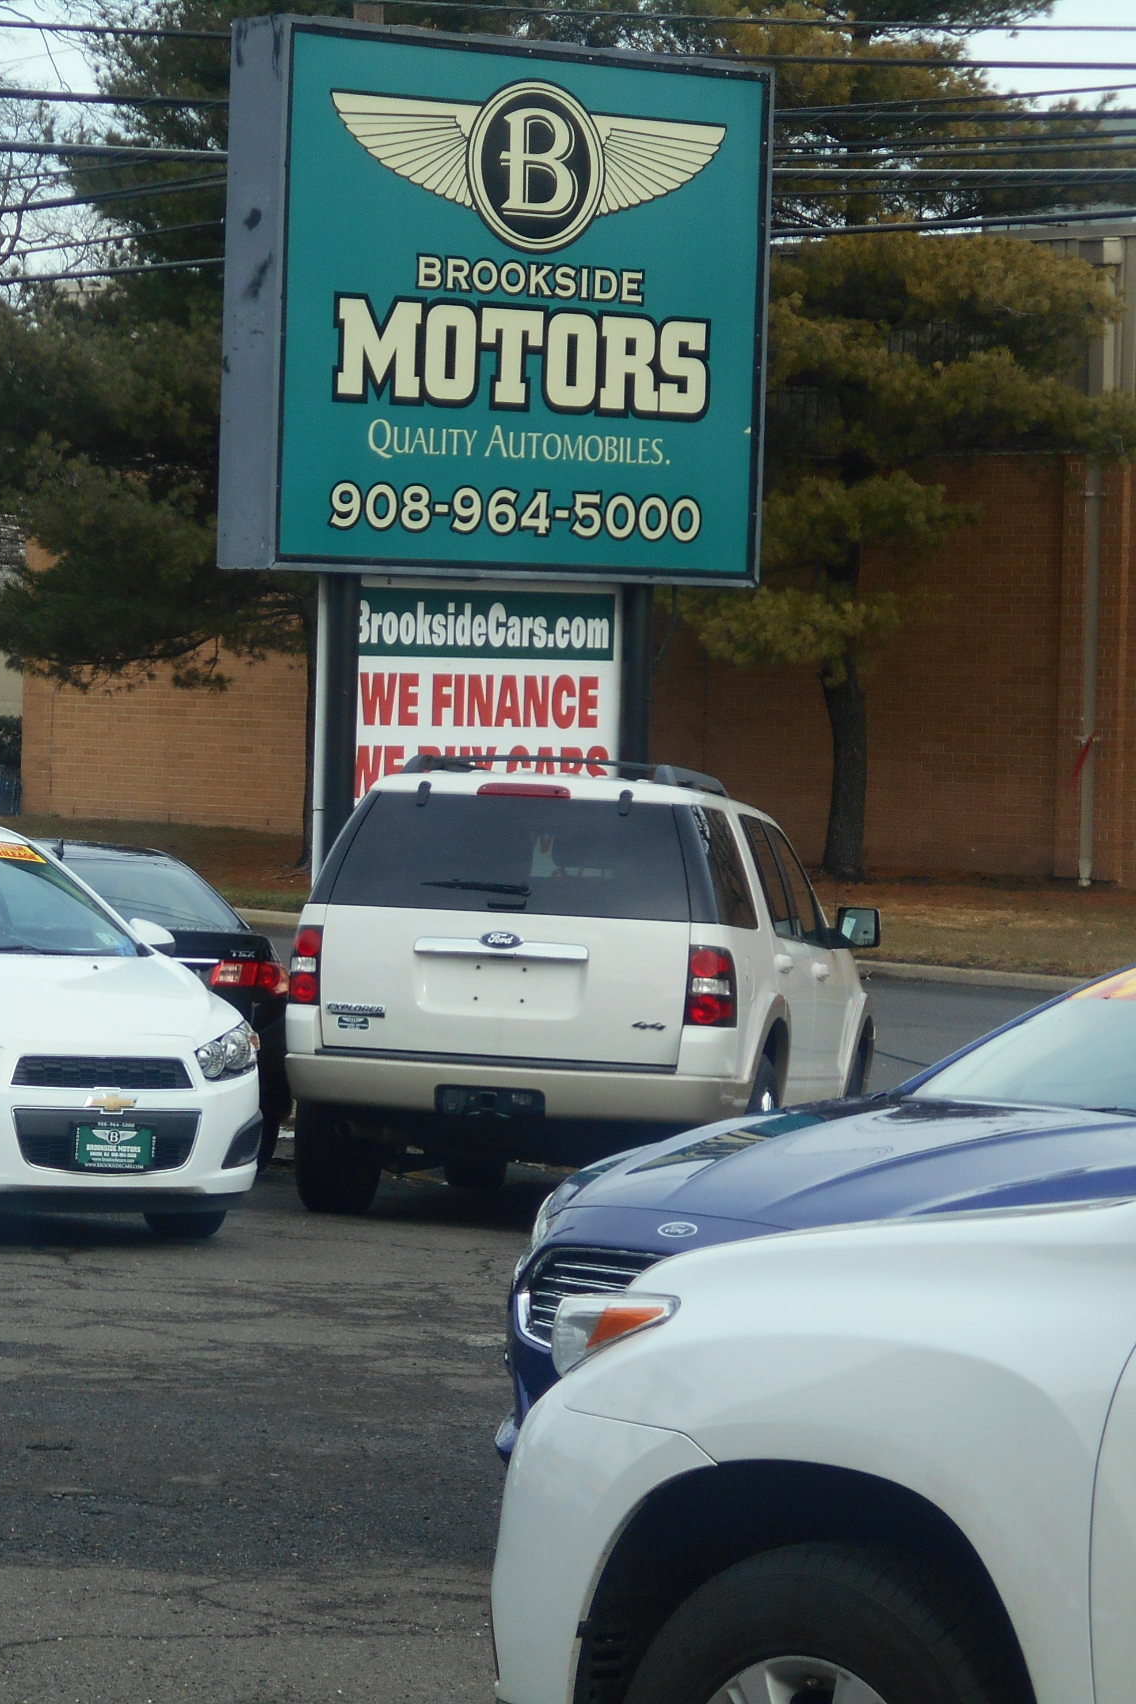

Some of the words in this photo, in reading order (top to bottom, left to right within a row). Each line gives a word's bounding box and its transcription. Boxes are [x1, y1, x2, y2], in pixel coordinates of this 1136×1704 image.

[416, 253, 645, 305] BROOKSIDE
[333, 293, 711, 421] MOTORS
[367, 417, 478, 458] QUALITY
[329, 480, 703, 542] 908-964-5000
[359, 672, 420, 726] WE
[431, 673, 600, 729] FINANCE
[487, 932, 514, 944] Ford
[326, 1002, 385, 1013] EXPLORER
